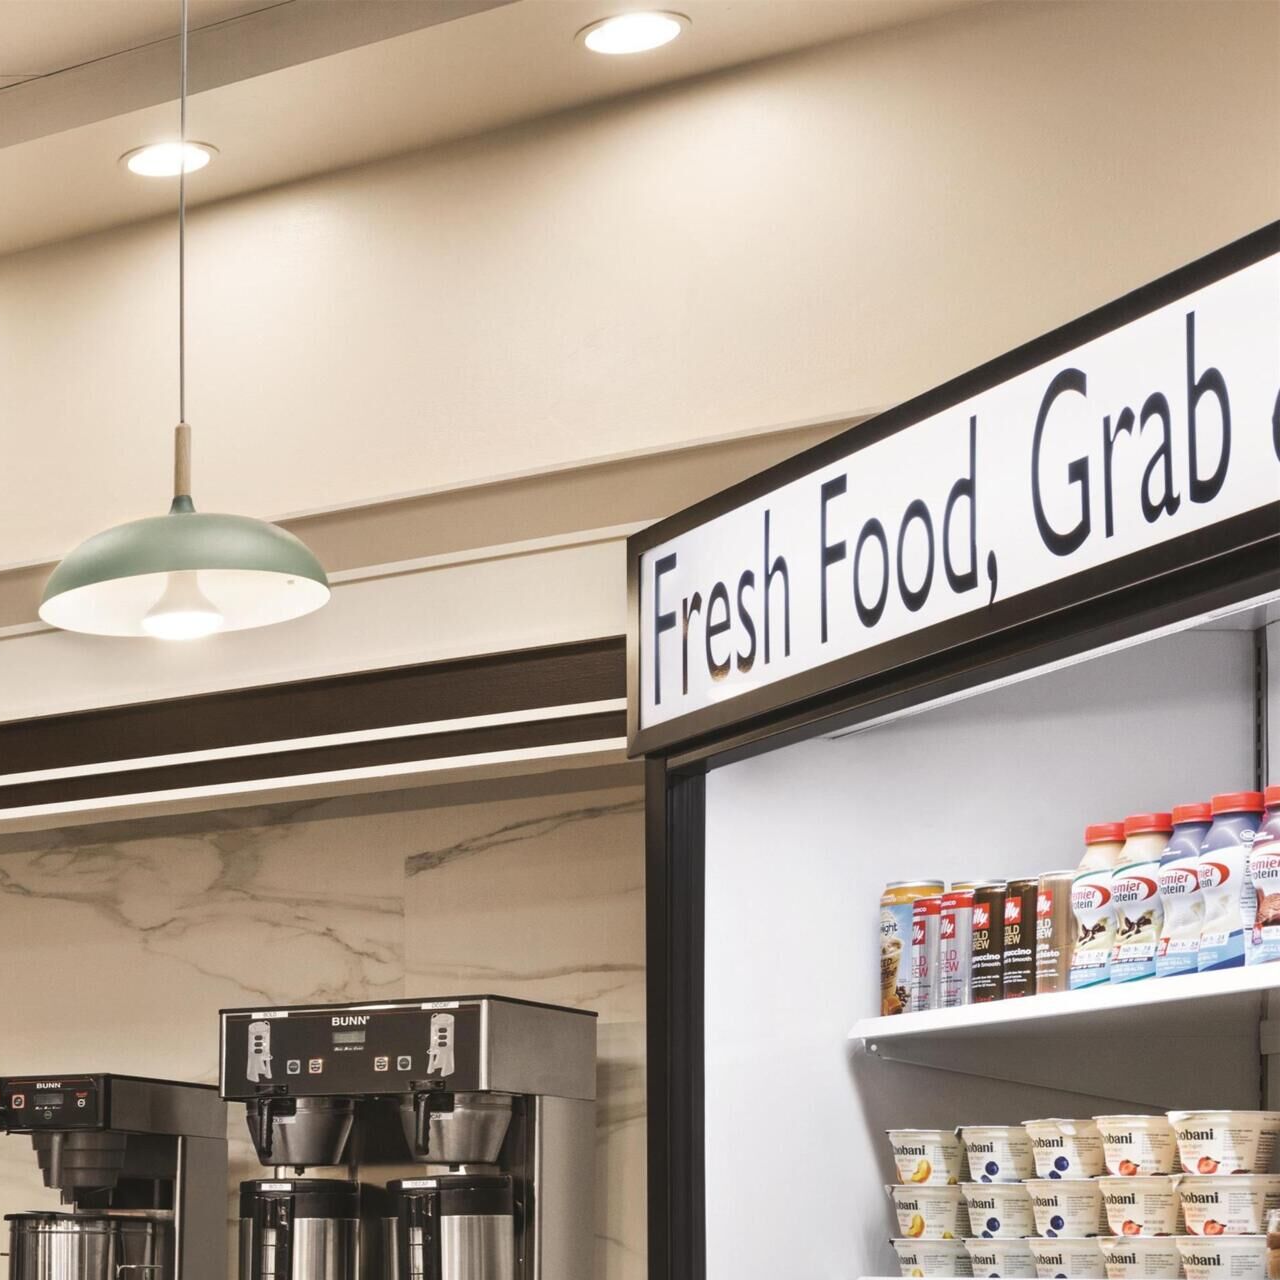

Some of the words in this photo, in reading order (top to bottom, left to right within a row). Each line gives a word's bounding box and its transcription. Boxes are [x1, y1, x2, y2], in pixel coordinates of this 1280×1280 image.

[653, 510, 790, 705] Fresh
[820, 415, 998, 645] Food,
[1032, 310, 1232, 557] Grab
[331, 1016, 367, 1027] BUNN
